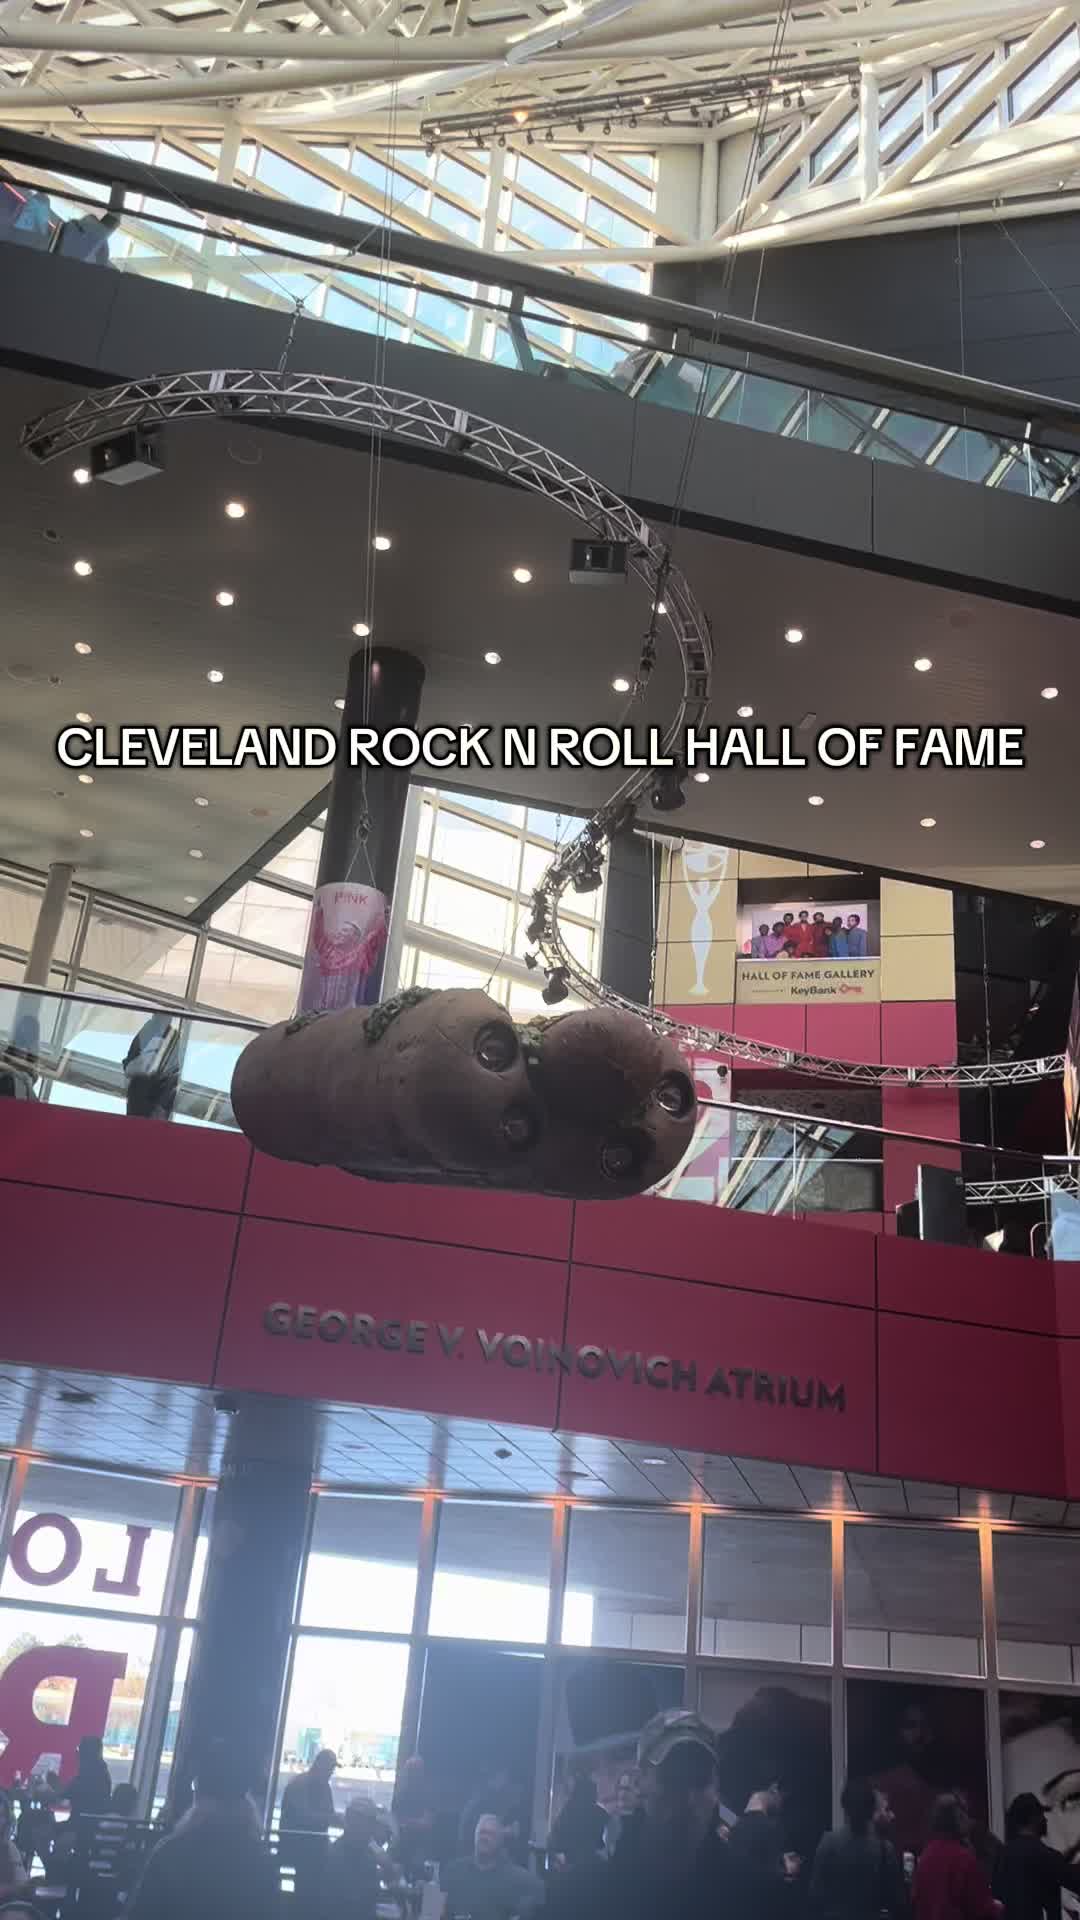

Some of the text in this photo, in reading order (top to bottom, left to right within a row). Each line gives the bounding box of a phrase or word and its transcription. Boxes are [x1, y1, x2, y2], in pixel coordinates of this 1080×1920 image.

[742, 969, 875, 981] HALL OF FAME GALLERY
[790, 985, 837, 996] KeyBank
[264, 1302, 848, 1415] GEORGE V. VOINOVICH ATRIUM
